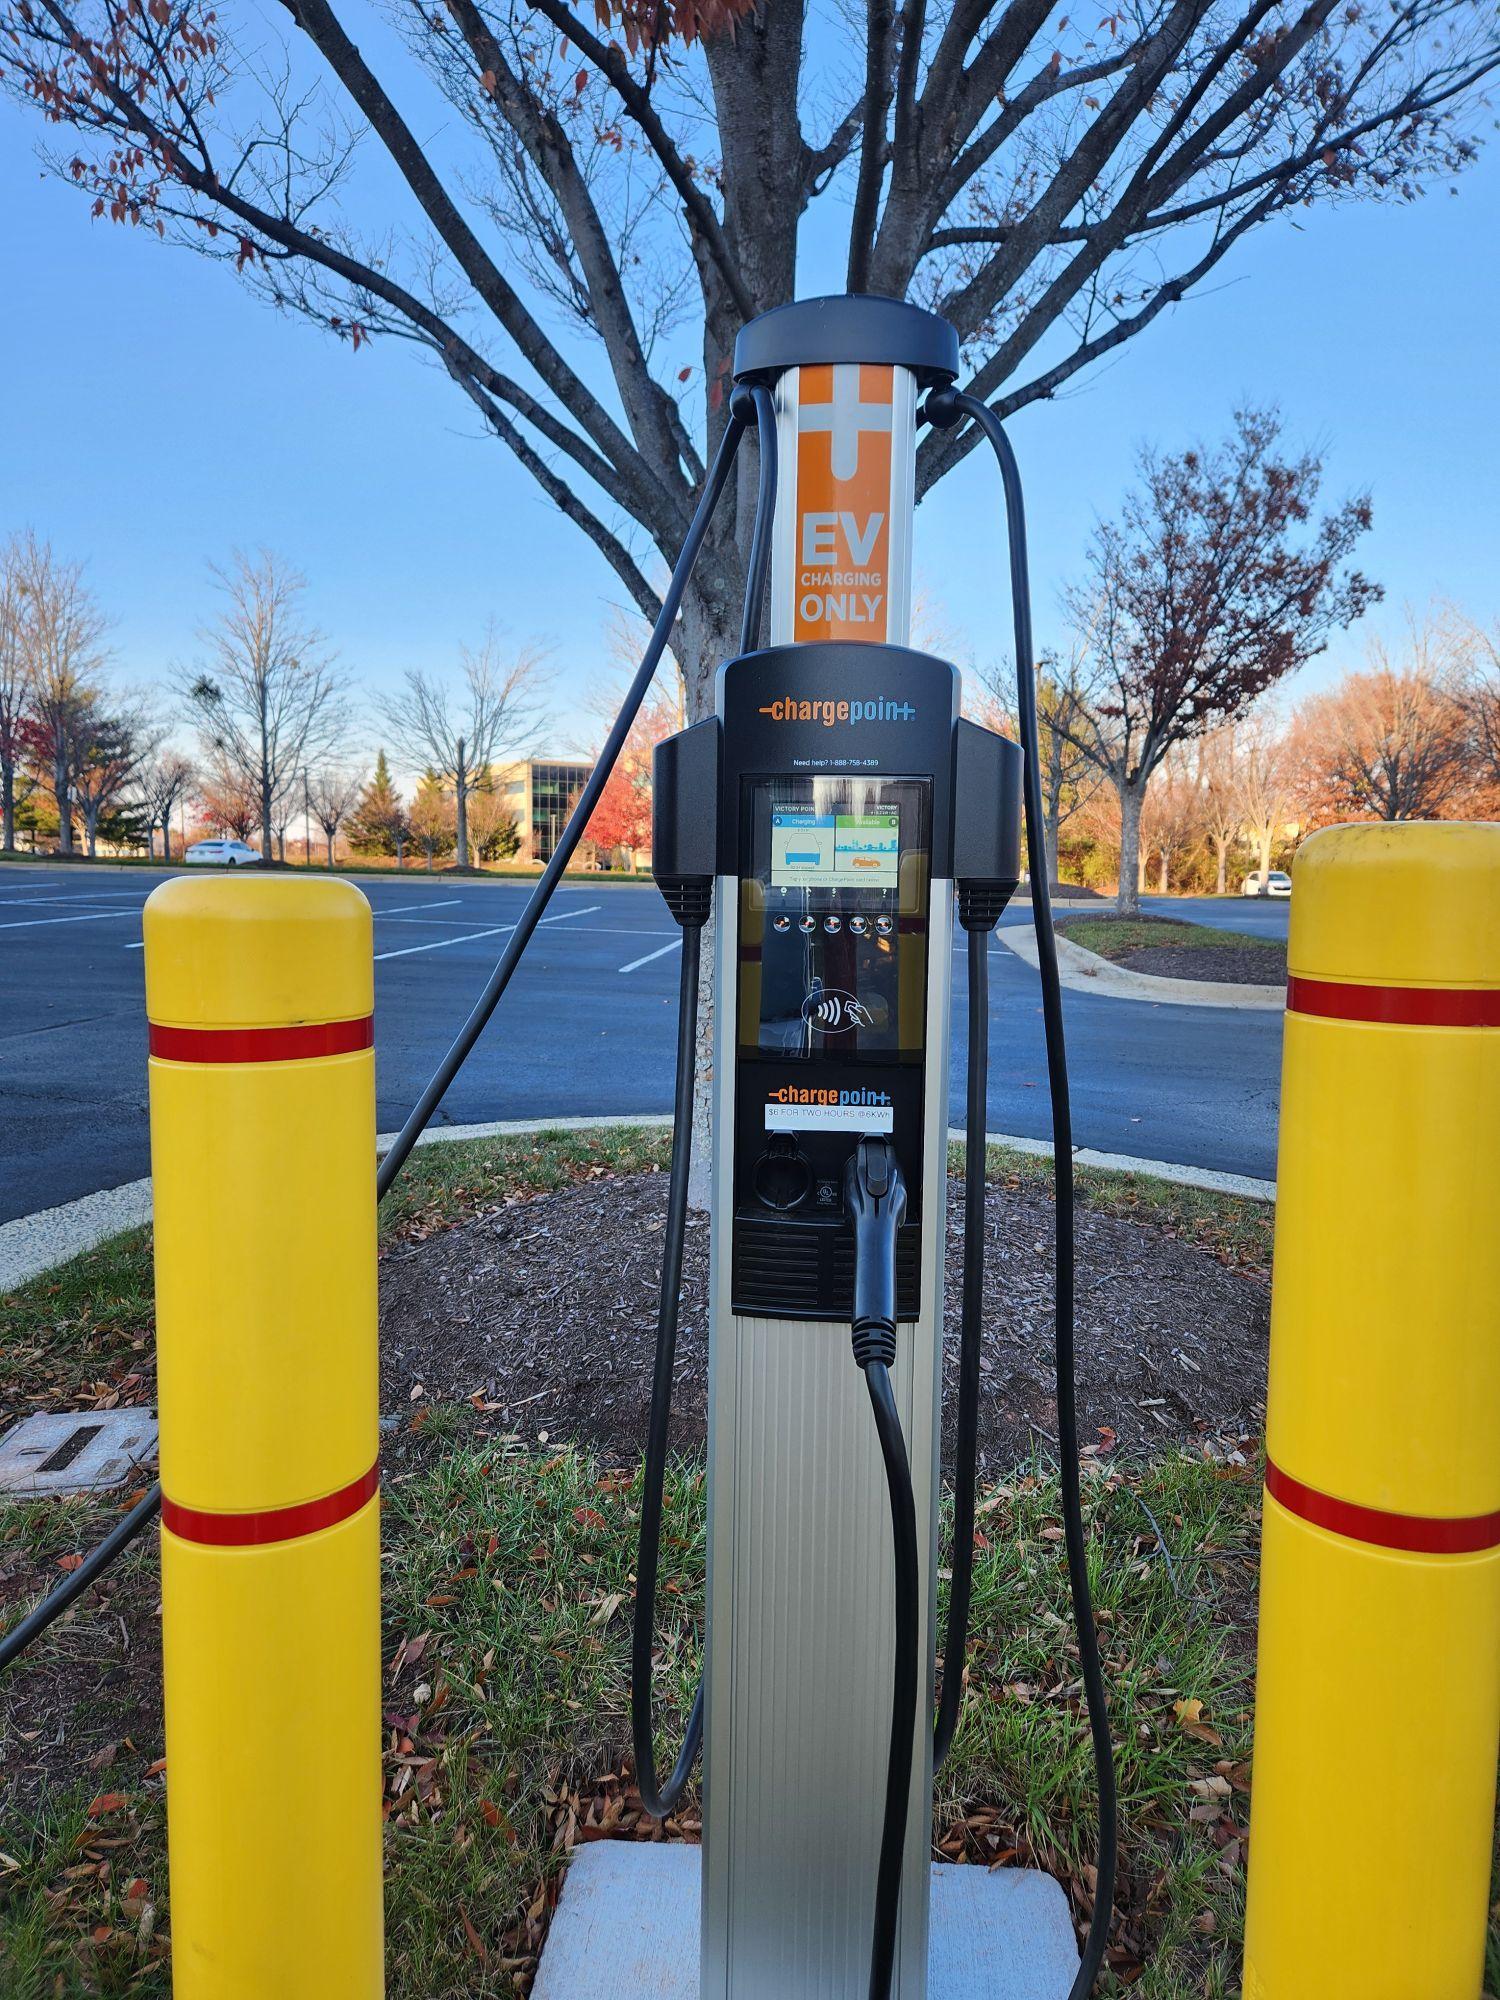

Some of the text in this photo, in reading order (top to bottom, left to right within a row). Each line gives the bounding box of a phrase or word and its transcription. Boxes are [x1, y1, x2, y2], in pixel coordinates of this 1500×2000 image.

[802, 512, 885, 566] EV
[801, 572, 881, 586] CHARGING
[800, 594, 883, 622] ONLY
[791, 818, 816, 826] Charging
[768, 1108, 779, 1116] $6
[802, 1109, 822, 1117] TWO
[825, 1109, 855, 1118] HOURS
